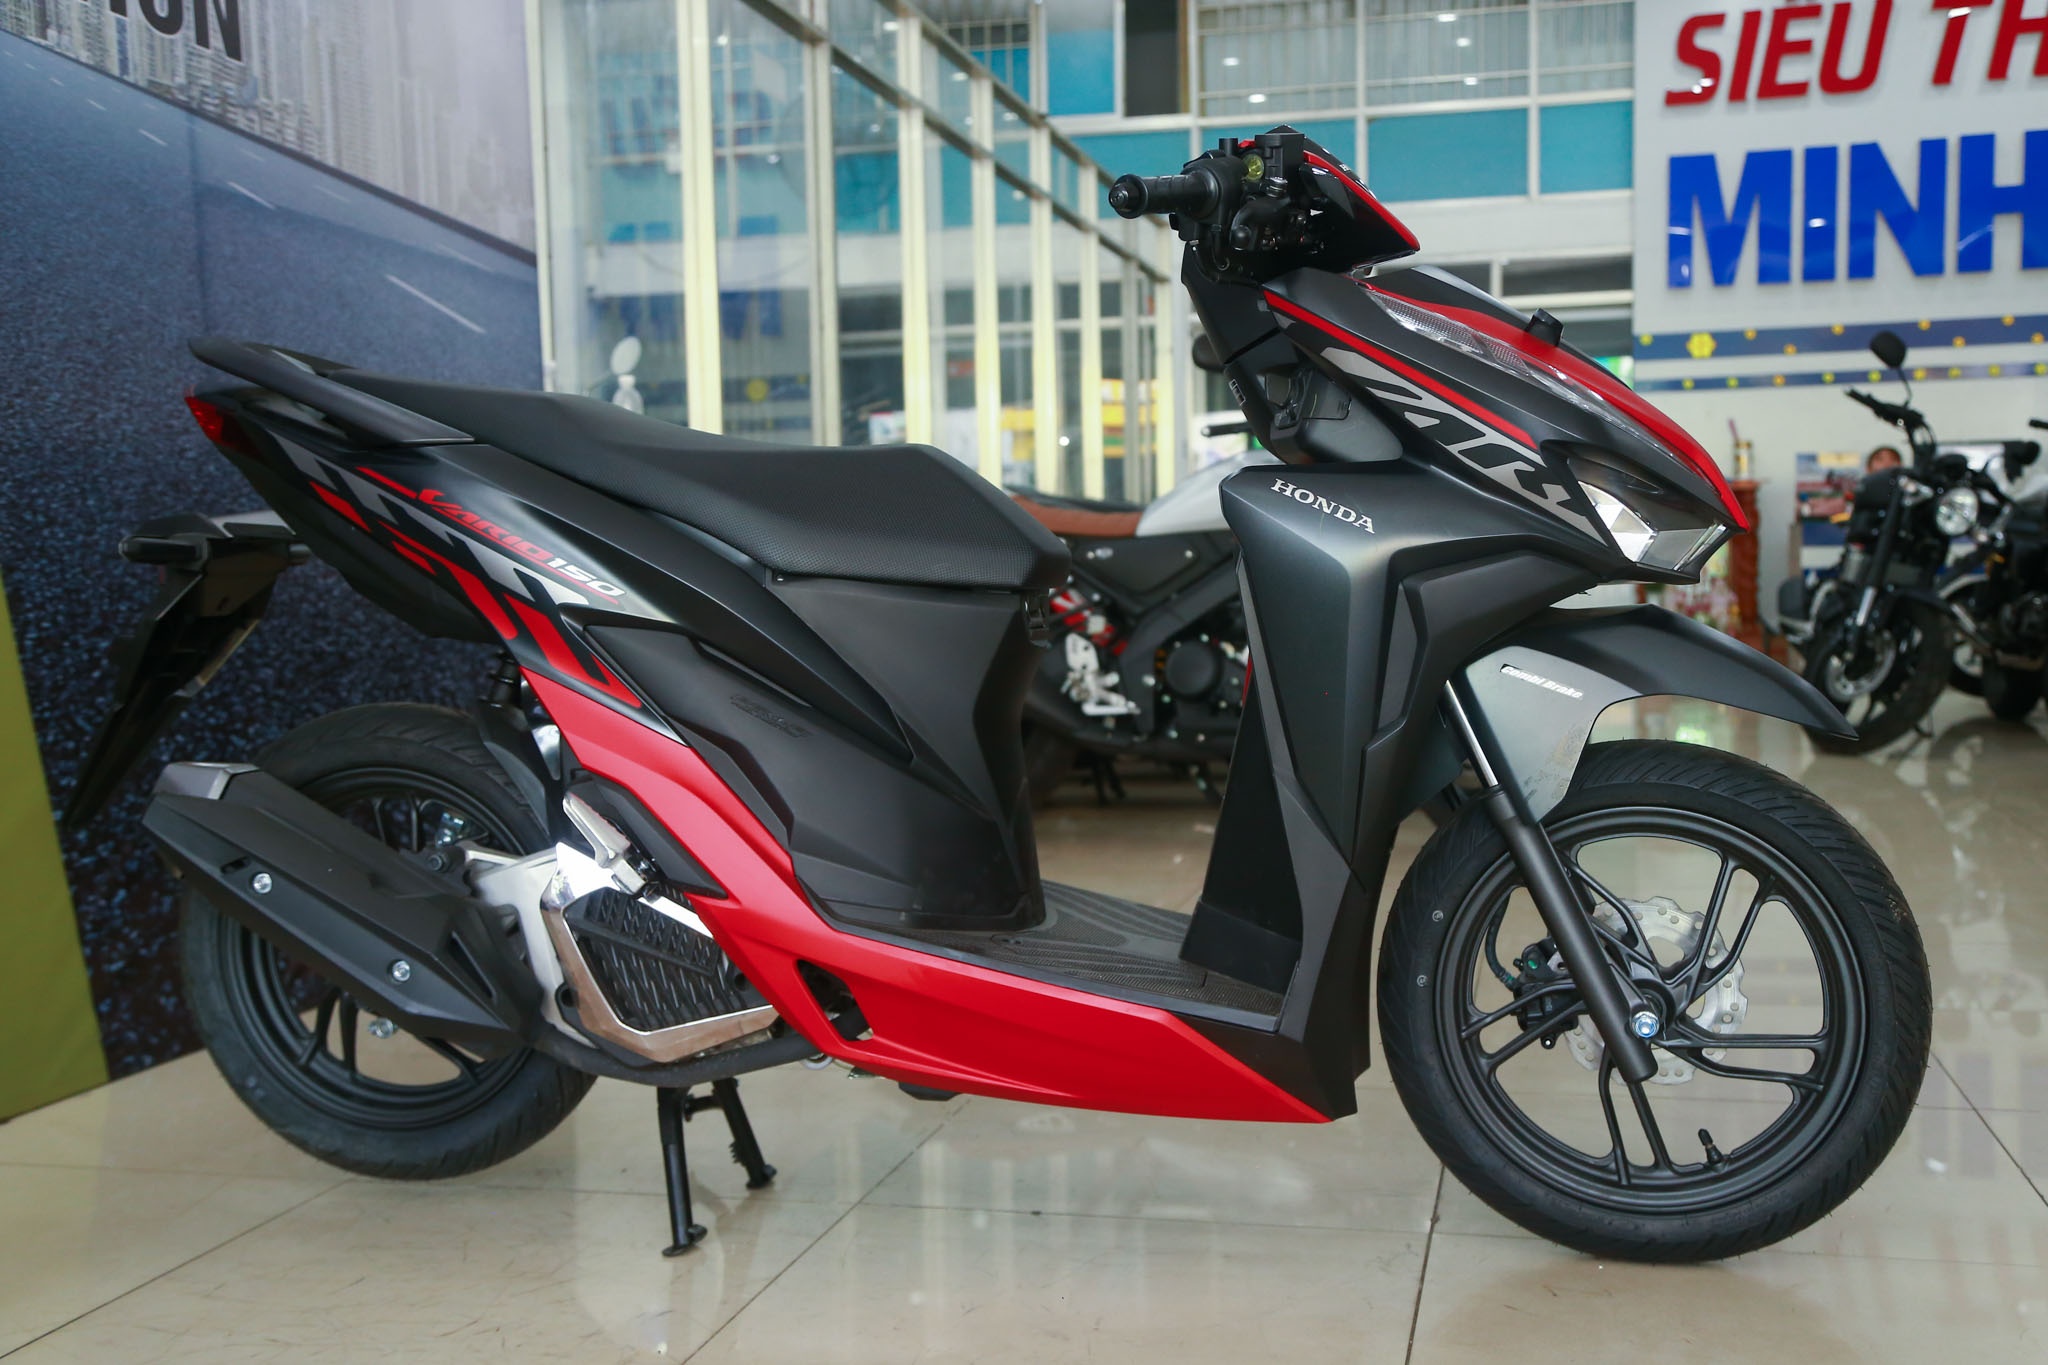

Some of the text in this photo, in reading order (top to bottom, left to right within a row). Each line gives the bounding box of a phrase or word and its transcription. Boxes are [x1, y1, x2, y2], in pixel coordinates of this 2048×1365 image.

[1667, 129, 2048, 289] MINH
[418, 488, 626, 597] VARIO 150
[1270, 478, 1376, 534] HONDA
[1541, 679, 1584, 699] Brake
